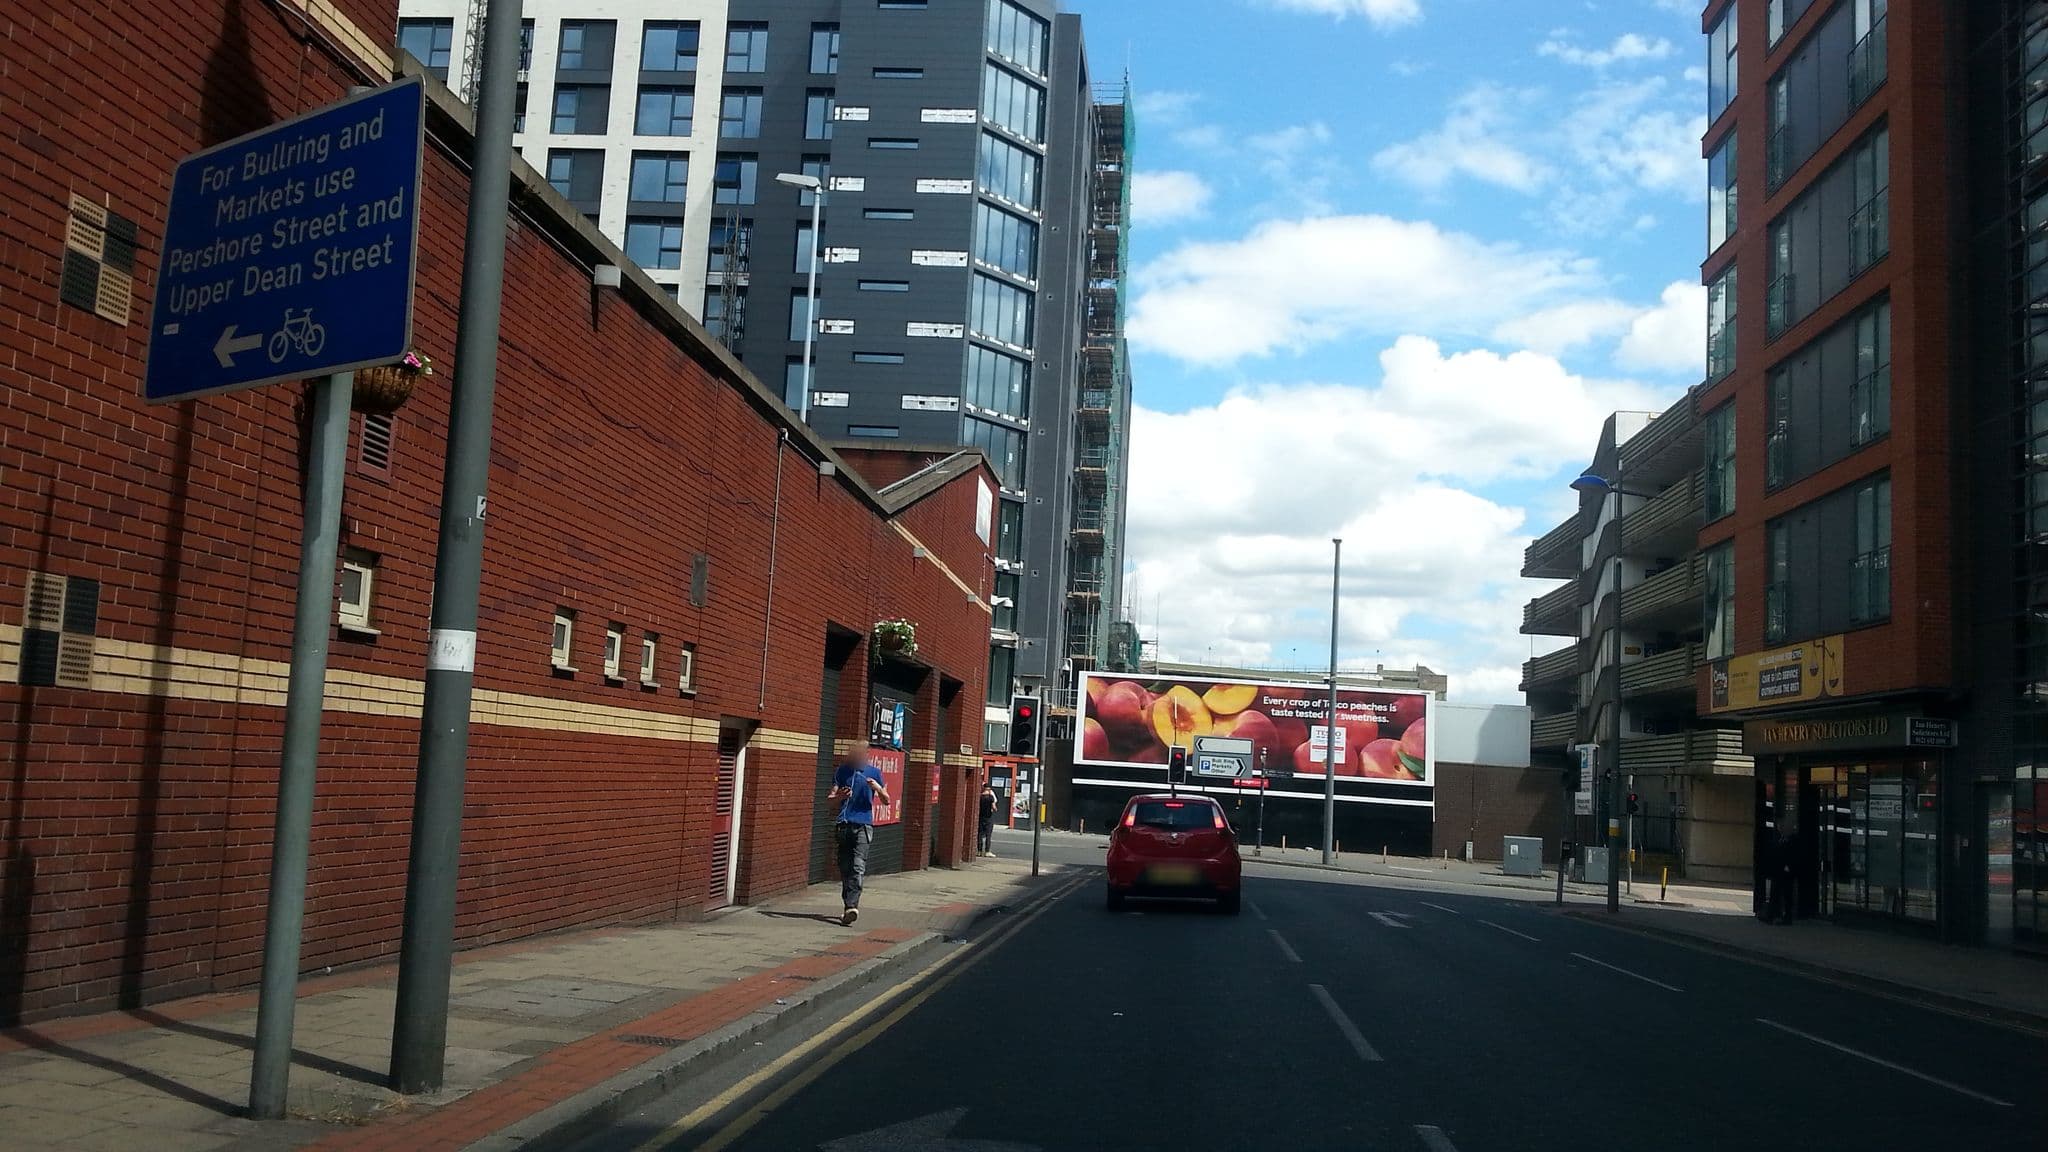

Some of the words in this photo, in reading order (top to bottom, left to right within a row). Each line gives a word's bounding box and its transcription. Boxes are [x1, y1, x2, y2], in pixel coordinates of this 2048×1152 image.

[200, 164, 234, 195] For
[242, 133, 330, 181] Bullring
[340, 108, 385, 151] and
[215, 178, 305, 227] Markets
[315, 167, 356, 198] use
[168, 232, 263, 277] Pershore
[272, 203, 348, 249] Street
[357, 186, 404, 228] and
[169, 278, 234, 316] Upper
[243, 261, 302, 297] Dean
[312, 233, 394, 280] Street
[1263, 696, 1288, 707] Every
[1289, 699, 1310, 709] crop
[1312, 699, 1323, 707] of
[1350, 702, 1388, 712] peaches
[1389, 704, 1397, 712] is
[1271, 708, 1294, 717] taste
[1295, 709, 1324, 719] tested
[1325, 710, 1340, 719] fr
[1341, 713, 1390, 723] sweetness.
[1813, 719, 1866, 740] SOLICITORS
[1869, 717, 1888, 735] LTD
[1202, 761, 1209, 769] P
